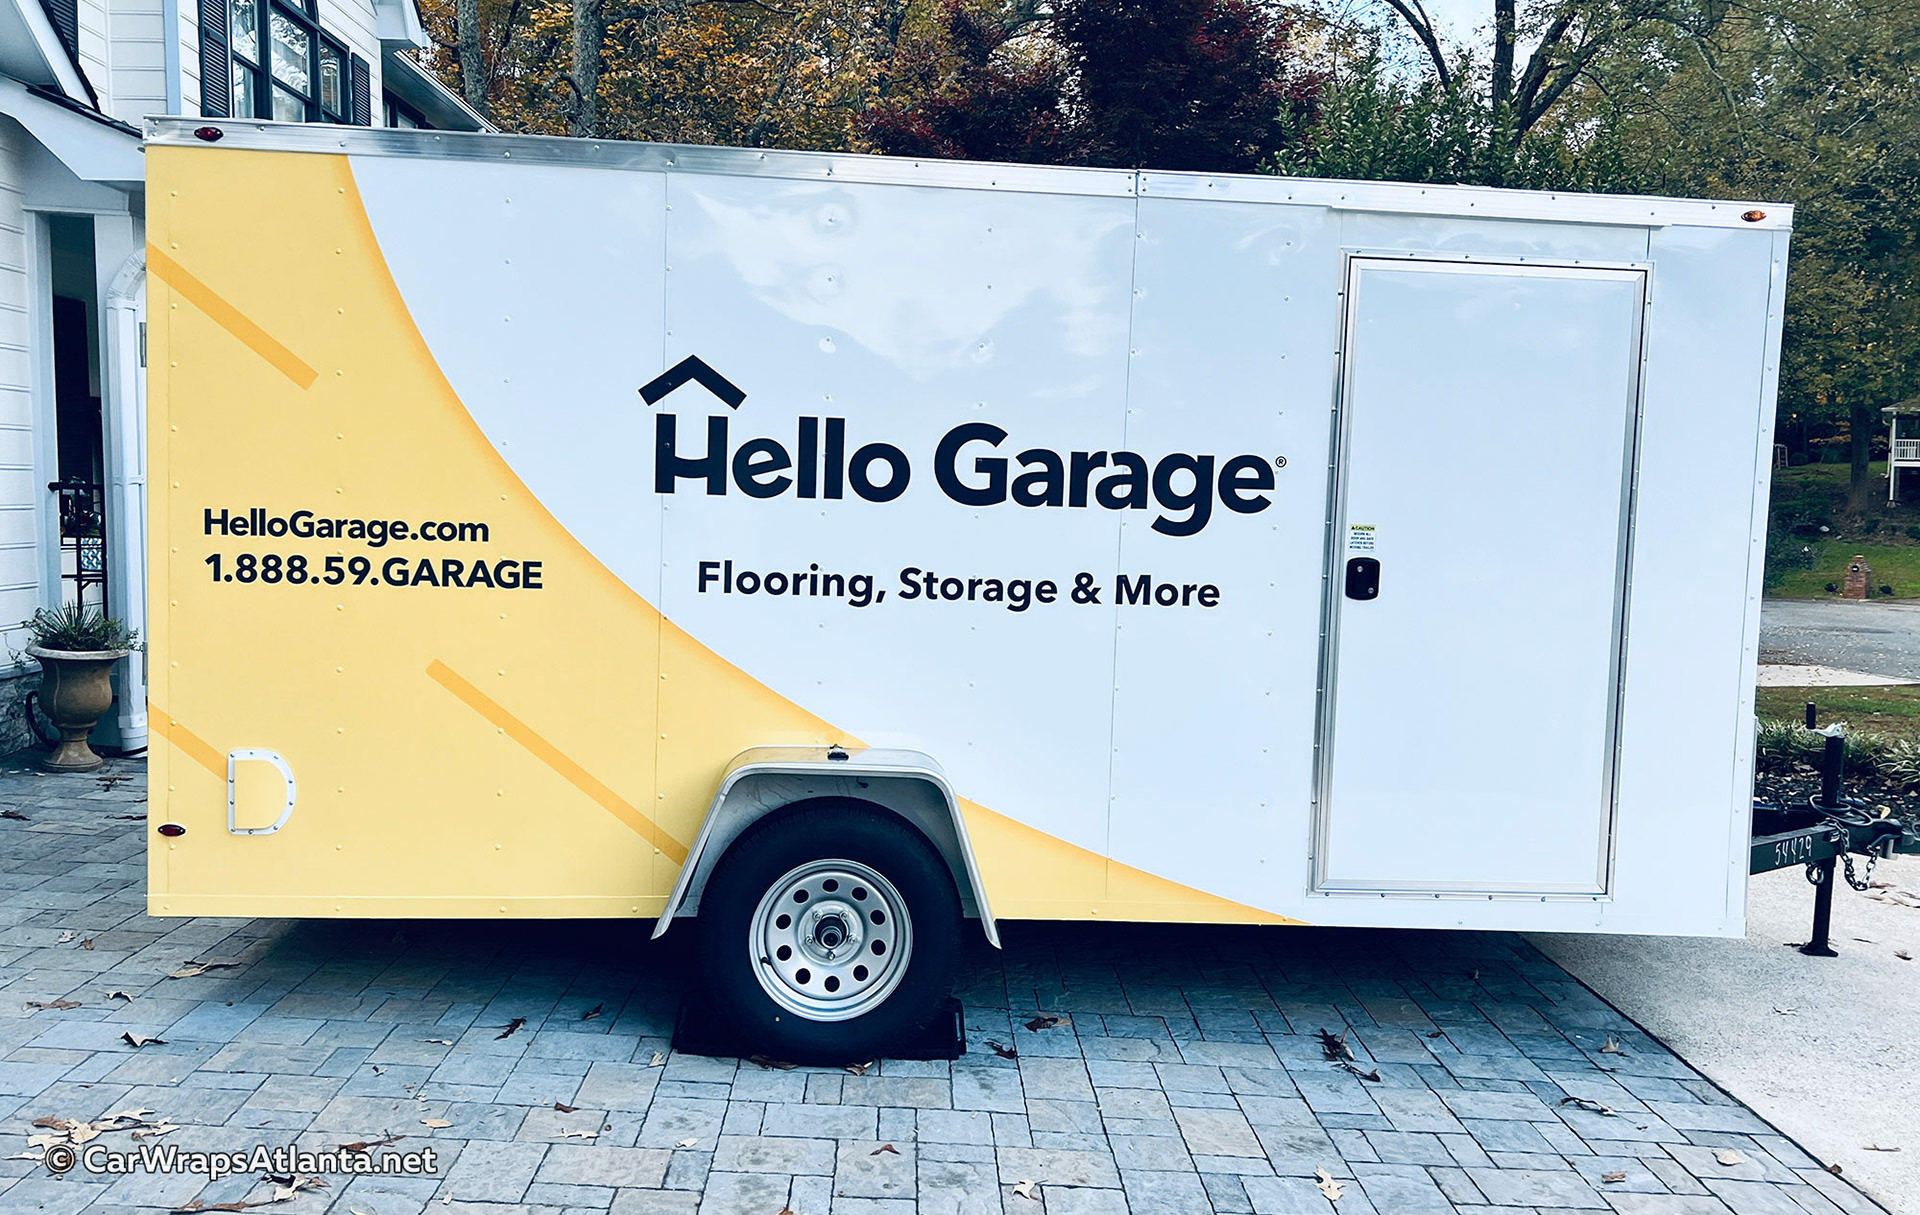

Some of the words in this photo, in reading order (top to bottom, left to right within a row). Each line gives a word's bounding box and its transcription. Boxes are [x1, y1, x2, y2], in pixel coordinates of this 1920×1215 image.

[654, 413, 911, 503] Hello
[204, 507, 489, 547] HelloGarage.com
[204, 553, 543, 589] 1.888.59.GARAGE
[698, 560, 886, 607] Flooring,
[899, 567, 1058, 612] Storage
[1071, 572, 1102, 605] &
[1115, 574, 1220, 607] More
[1774, 835, 1812, 866] 54429
